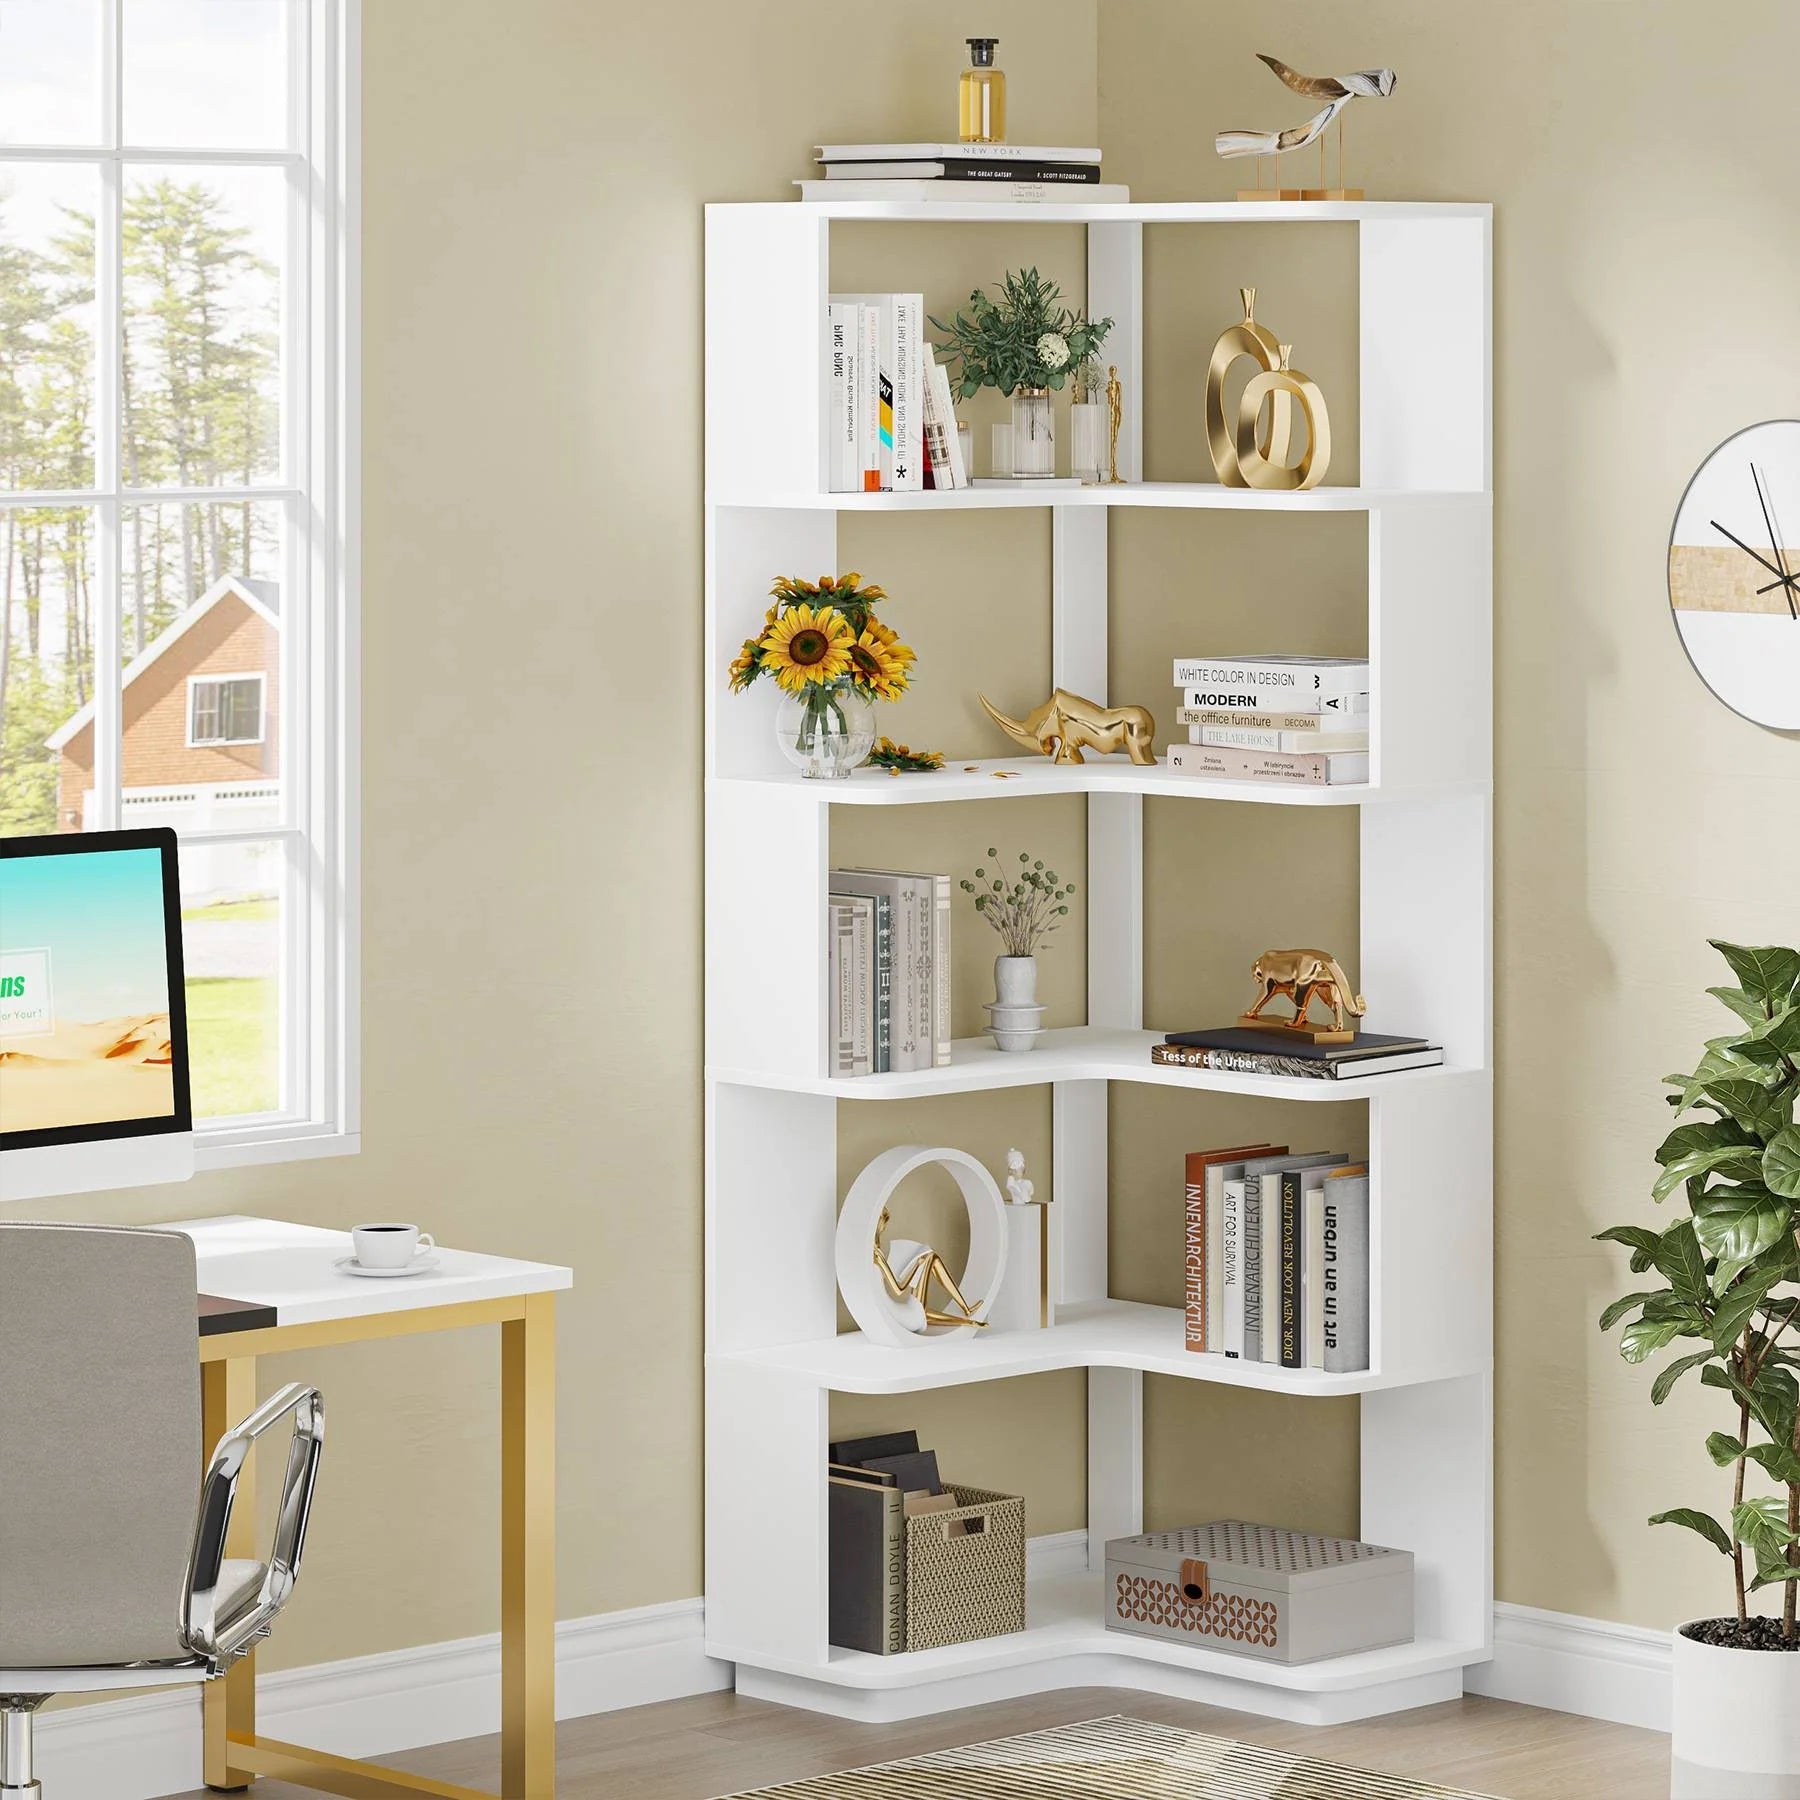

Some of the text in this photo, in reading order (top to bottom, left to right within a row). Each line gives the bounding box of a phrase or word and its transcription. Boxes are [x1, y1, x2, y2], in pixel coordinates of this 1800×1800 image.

[963, 147, 1023, 156] NEW YORK
[1179, 668, 1295, 686] WHITE COLOR IN DESIGN
[1314, 674, 1320, 689] W
[1194, 693, 1257, 707] MODERN
[1326, 698, 1339, 709] A
[1184, 711, 1199, 723] the
[1231, 714, 1271, 727] furniture
[1285, 718, 1315, 728] DECOMA
[1207, 731, 1274, 746] THE LAKE HOUSE
[1173, 757, 1182, 766] 2
[0, 976, 25, 998] ns
[1161, 1051, 1257, 1069] Tess of the Urber
[1225, 1192, 1237, 1286] ART FOR SURVIVAL
[1185, 1183, 1201, 1342] INNENARCHITEKTUR
[1245, 1174, 1260, 1333] INNENARCHITEKTUR
[1284, 1182, 1294, 1360] DIOR. NEW LOOK REVOLUTION
[1324, 1205, 1337, 1349] art in an urban
[889, 1533, 900, 1586] DOYLE
[889, 1594, 900, 1653] CONAN
